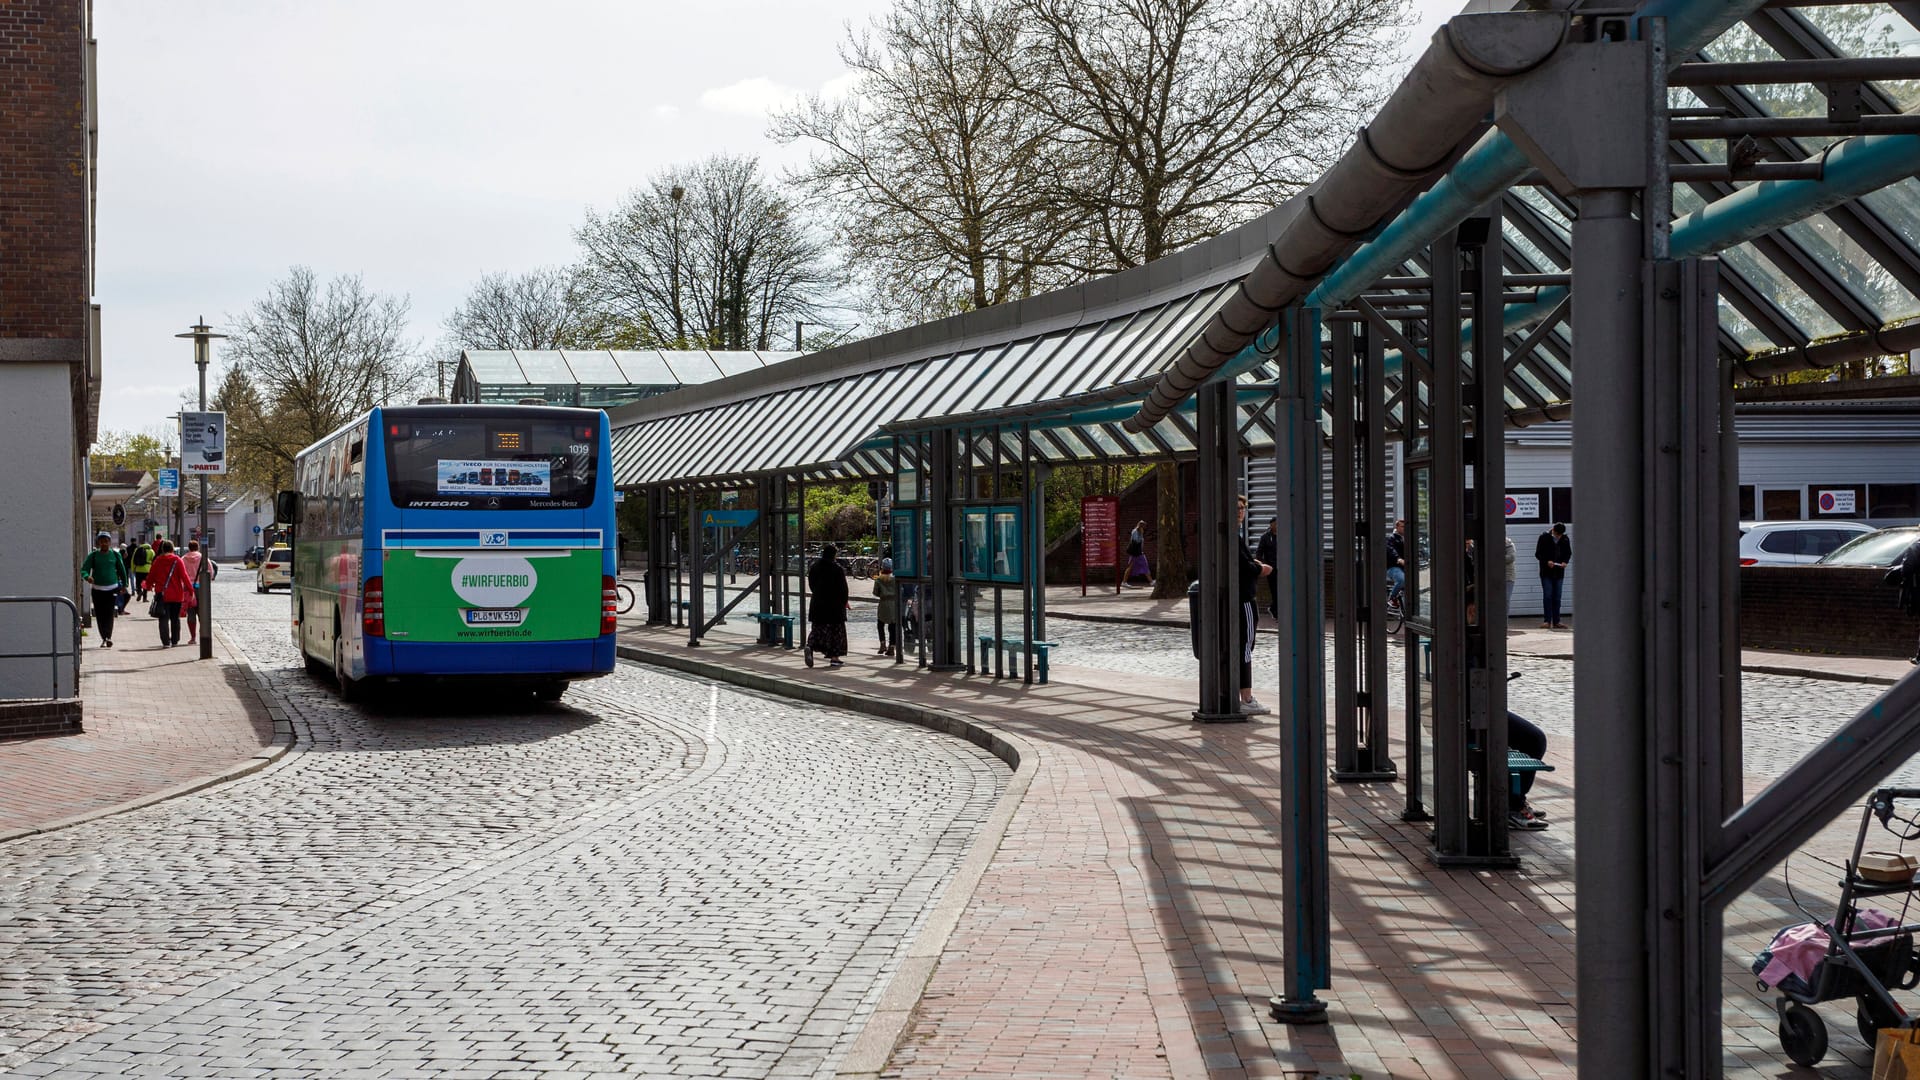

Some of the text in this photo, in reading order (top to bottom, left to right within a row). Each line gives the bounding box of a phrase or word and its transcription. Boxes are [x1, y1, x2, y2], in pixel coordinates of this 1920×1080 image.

[569, 445, 589, 454] 1019
[530, 500, 578, 508] Mercedes-Benz
[705, 513, 714, 523] A
[461, 574, 529, 587] #WIRFUERBIO
[493, 611, 503, 620] VK
[505, 611, 519, 620] 519
[457, 629, 532, 637] www.wirfuerbio.de
